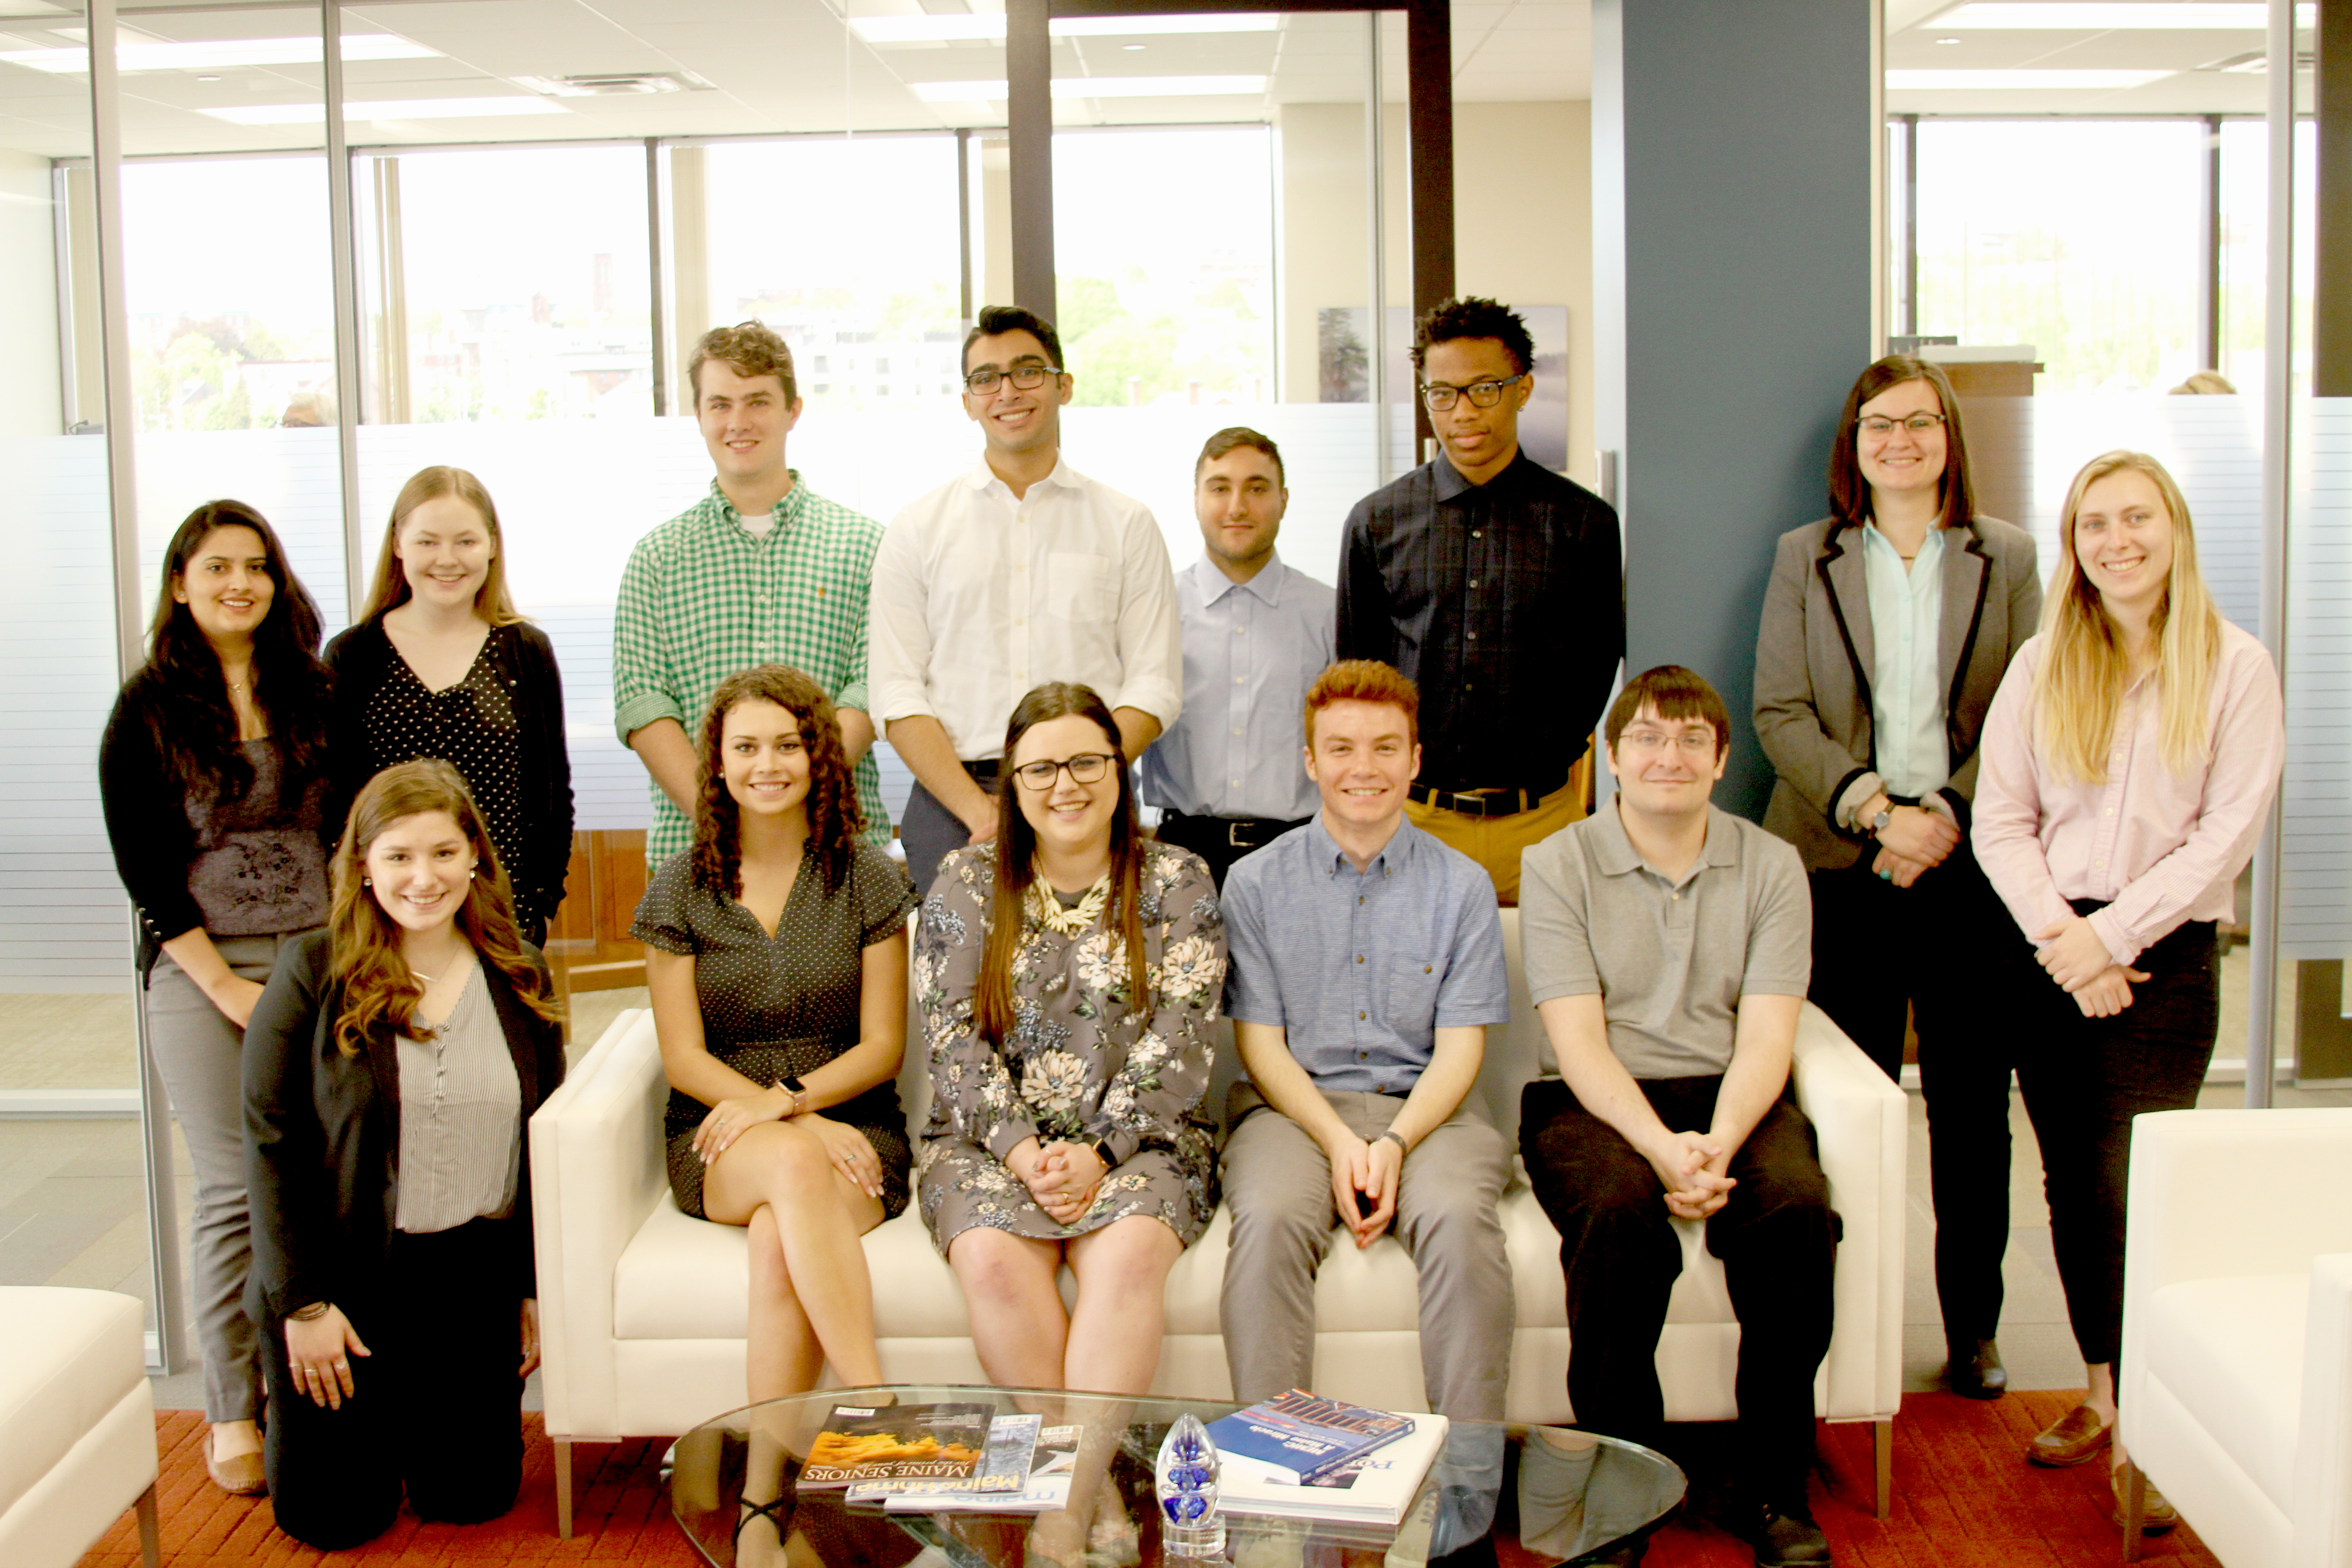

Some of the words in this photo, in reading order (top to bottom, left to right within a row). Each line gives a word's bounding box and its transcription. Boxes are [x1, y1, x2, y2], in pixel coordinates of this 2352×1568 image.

[804, 1466, 892, 1481] SENIORS
[896, 1465, 970, 1478] MAINE
[855, 1481, 935, 1492] Home
[940, 1475, 1020, 1490] Maine
